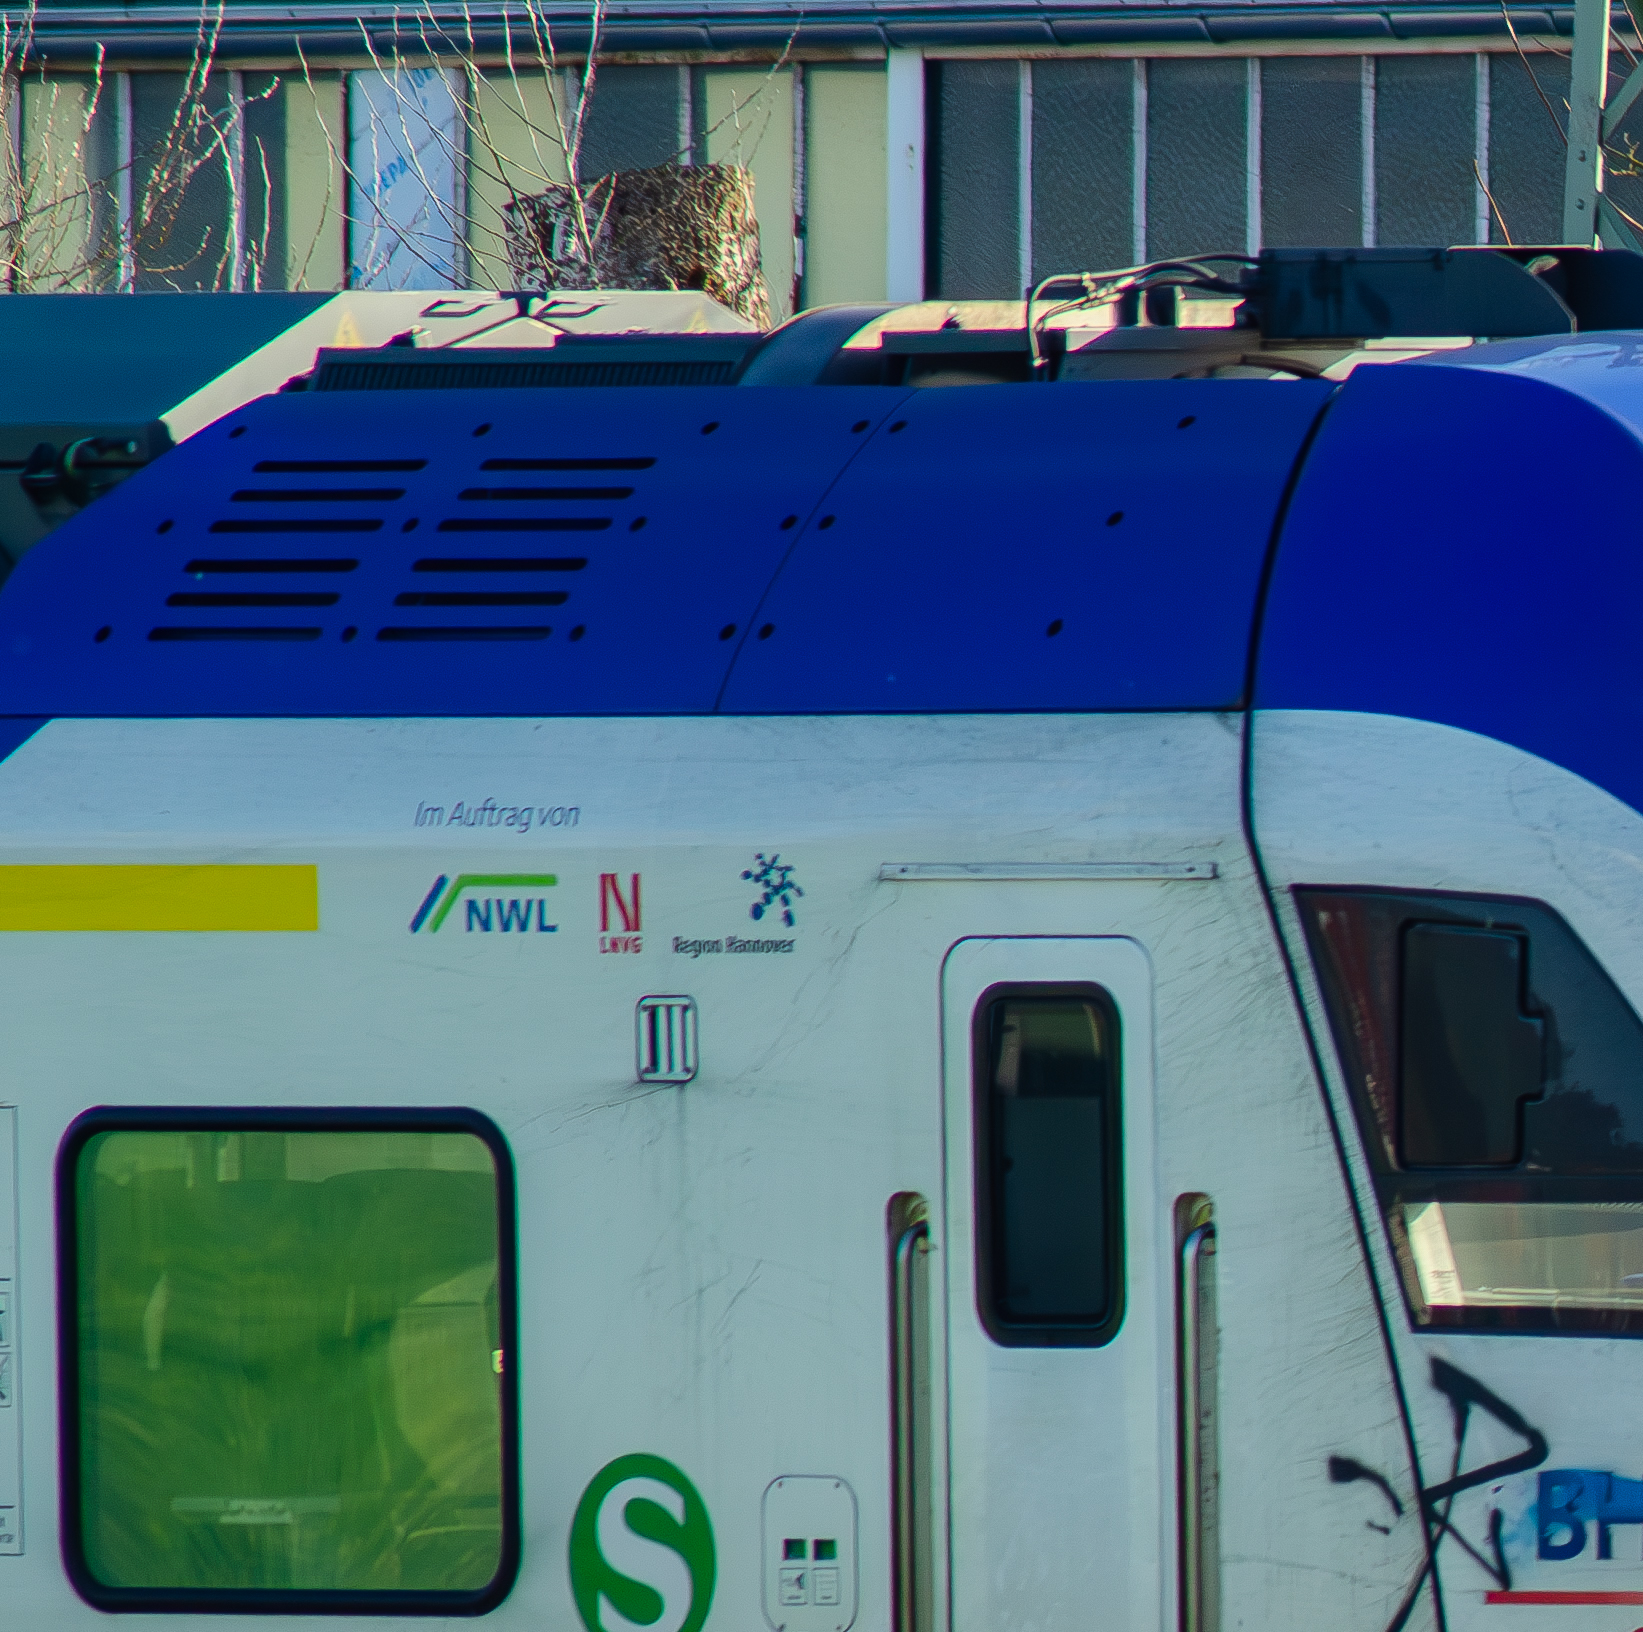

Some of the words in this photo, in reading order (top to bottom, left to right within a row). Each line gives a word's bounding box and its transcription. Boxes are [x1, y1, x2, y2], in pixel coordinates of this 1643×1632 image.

[414, 800, 444, 827] Im
[446, 797, 535, 834] Auftrag
[538, 806, 582, 827] von
[466, 898, 558, 933] NWL
